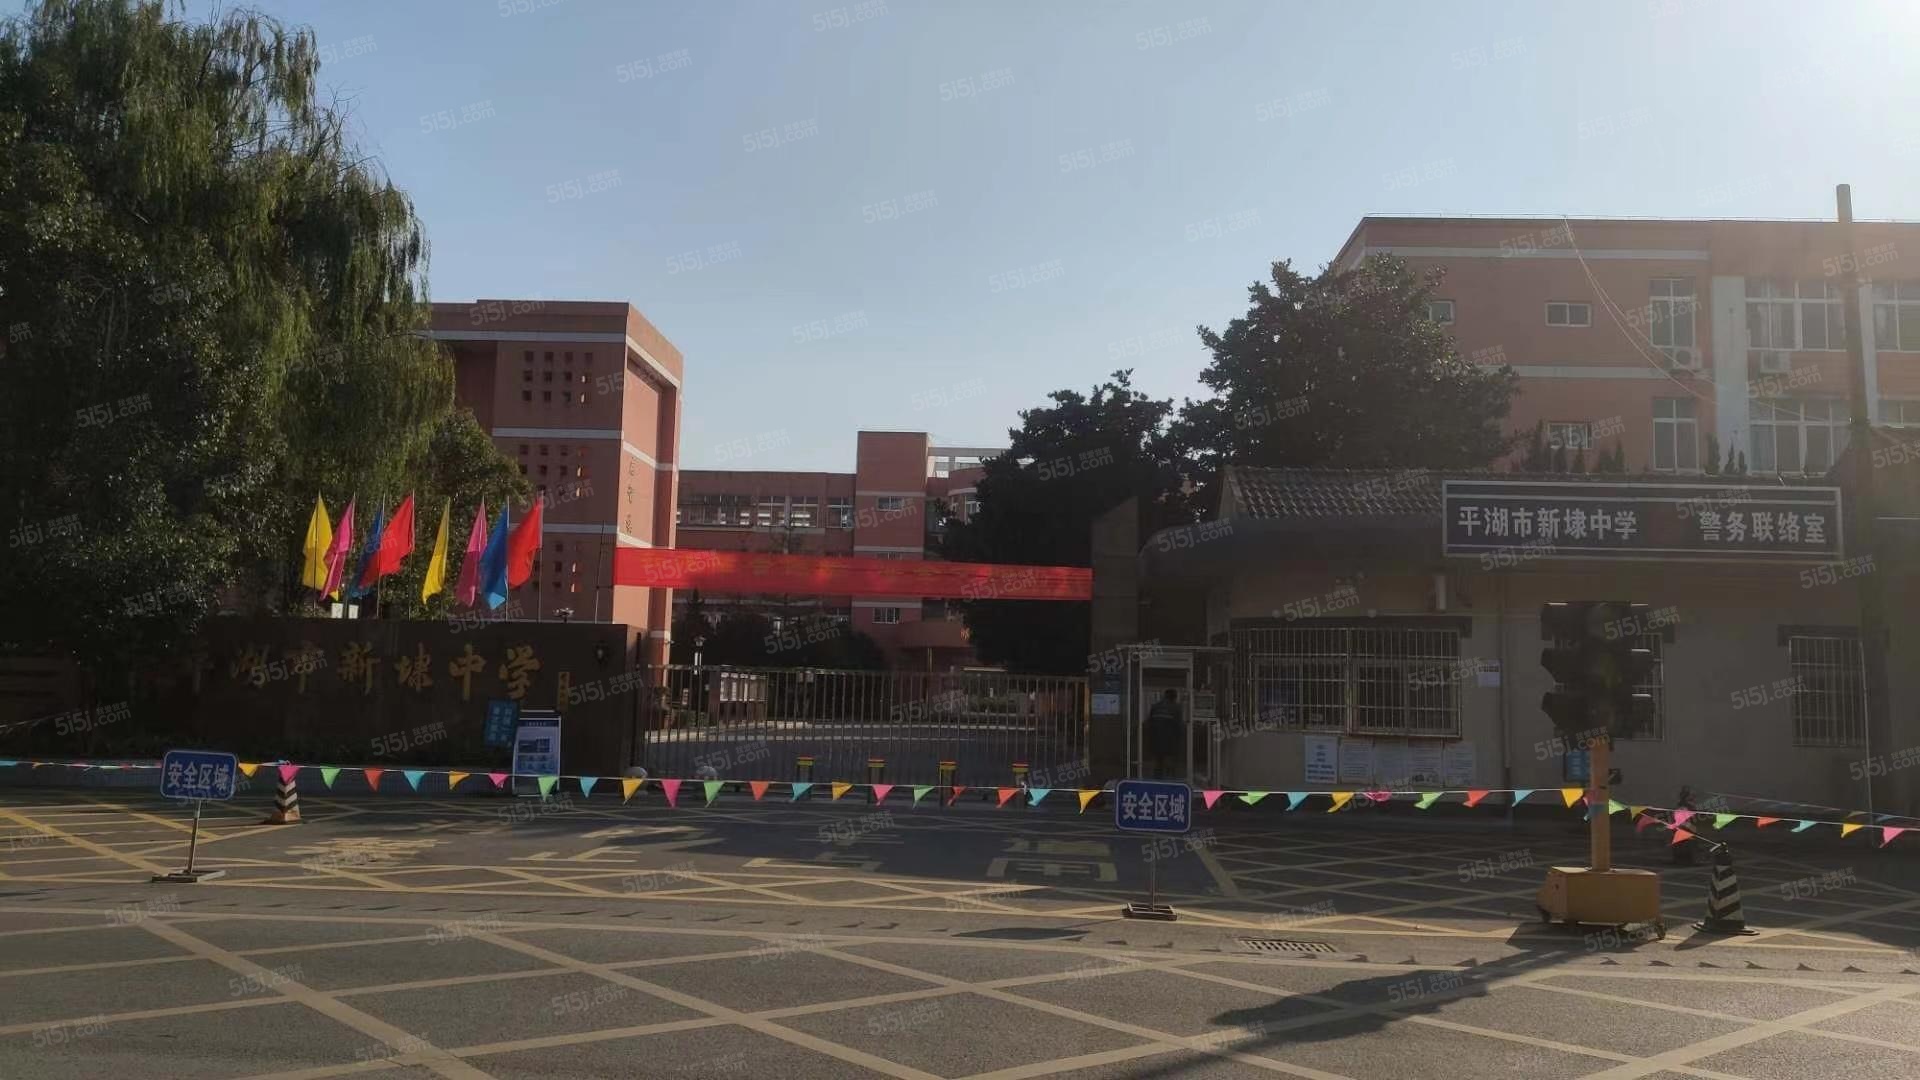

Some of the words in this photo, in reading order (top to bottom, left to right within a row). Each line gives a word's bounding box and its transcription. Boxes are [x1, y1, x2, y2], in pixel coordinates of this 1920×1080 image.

[1457, 506, 1637, 540] 平湖市新埭中学
[1699, 511, 1825, 544] 警务联络室
[168, 761, 231, 790] 安全区域
[1122, 791, 1184, 823] 安全区域
